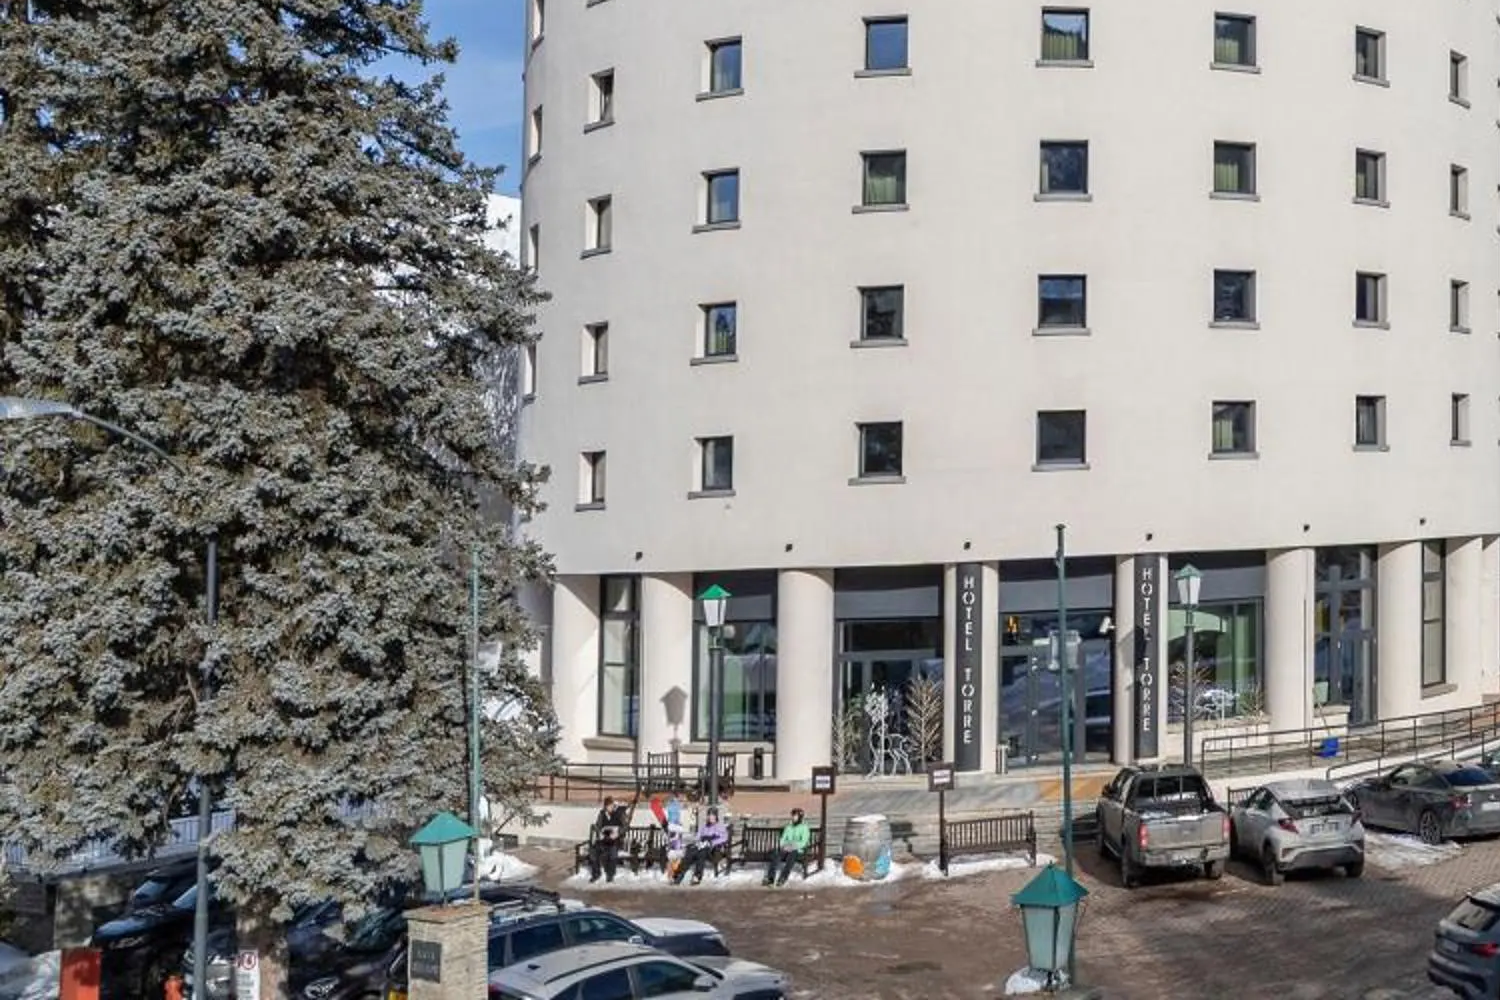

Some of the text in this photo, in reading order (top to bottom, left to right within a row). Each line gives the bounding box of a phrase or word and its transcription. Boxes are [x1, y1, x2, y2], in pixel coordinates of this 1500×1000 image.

[960, 576, 976, 744] HOTEL TORRE
[1139, 567, 1154, 731] HOTEL TORRE
